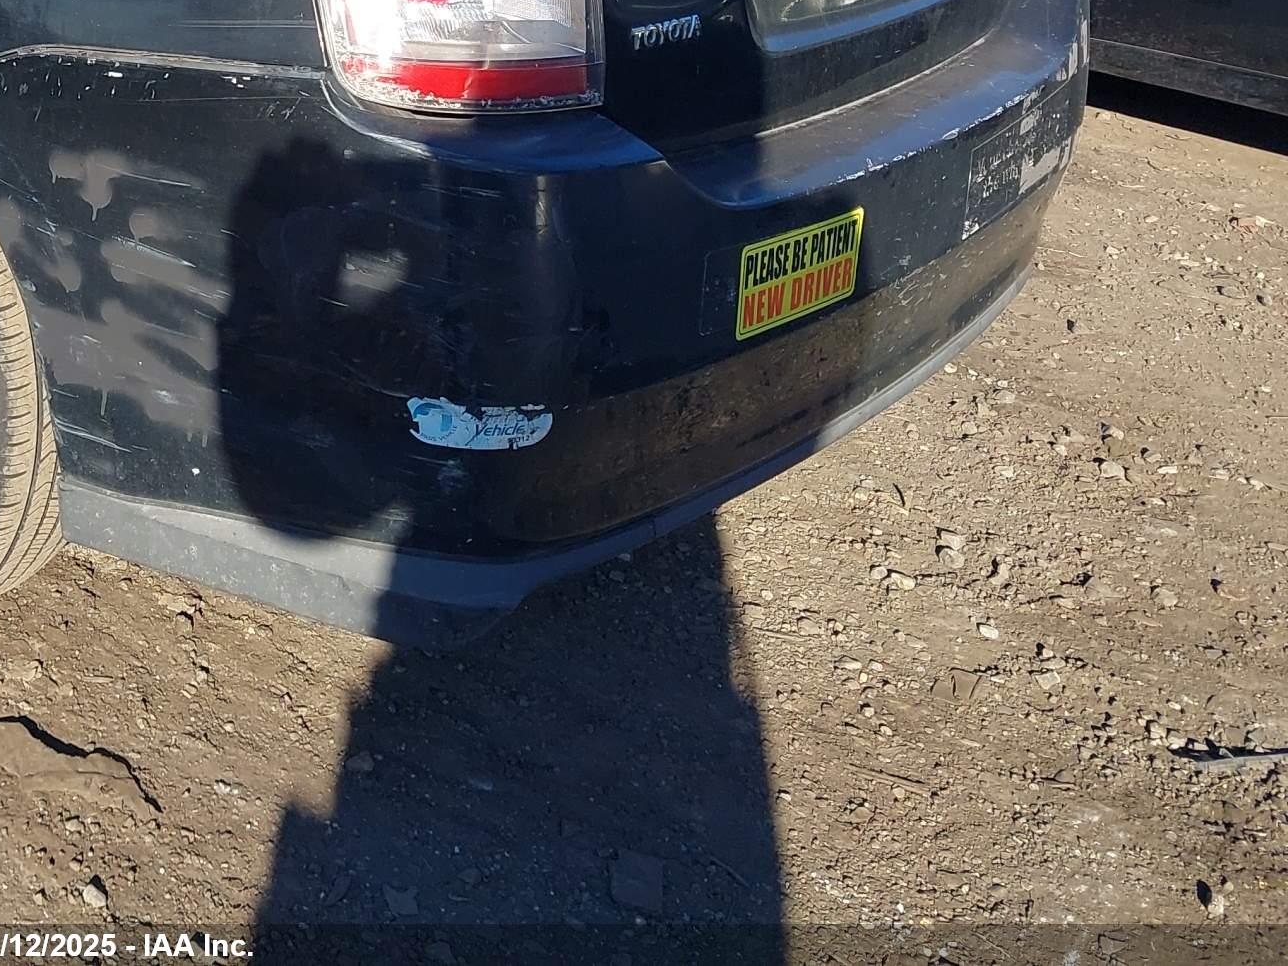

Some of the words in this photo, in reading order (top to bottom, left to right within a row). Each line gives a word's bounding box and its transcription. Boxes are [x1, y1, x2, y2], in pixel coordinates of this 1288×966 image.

[631, 14, 701, 51] TOYOTA
[744, 242, 791, 291] PLEASE
[791, 236, 809, 273] BE
[809, 218, 858, 267] PATIENT
[742, 280, 786, 330] NEW
[790, 257, 854, 311] DRIVER
